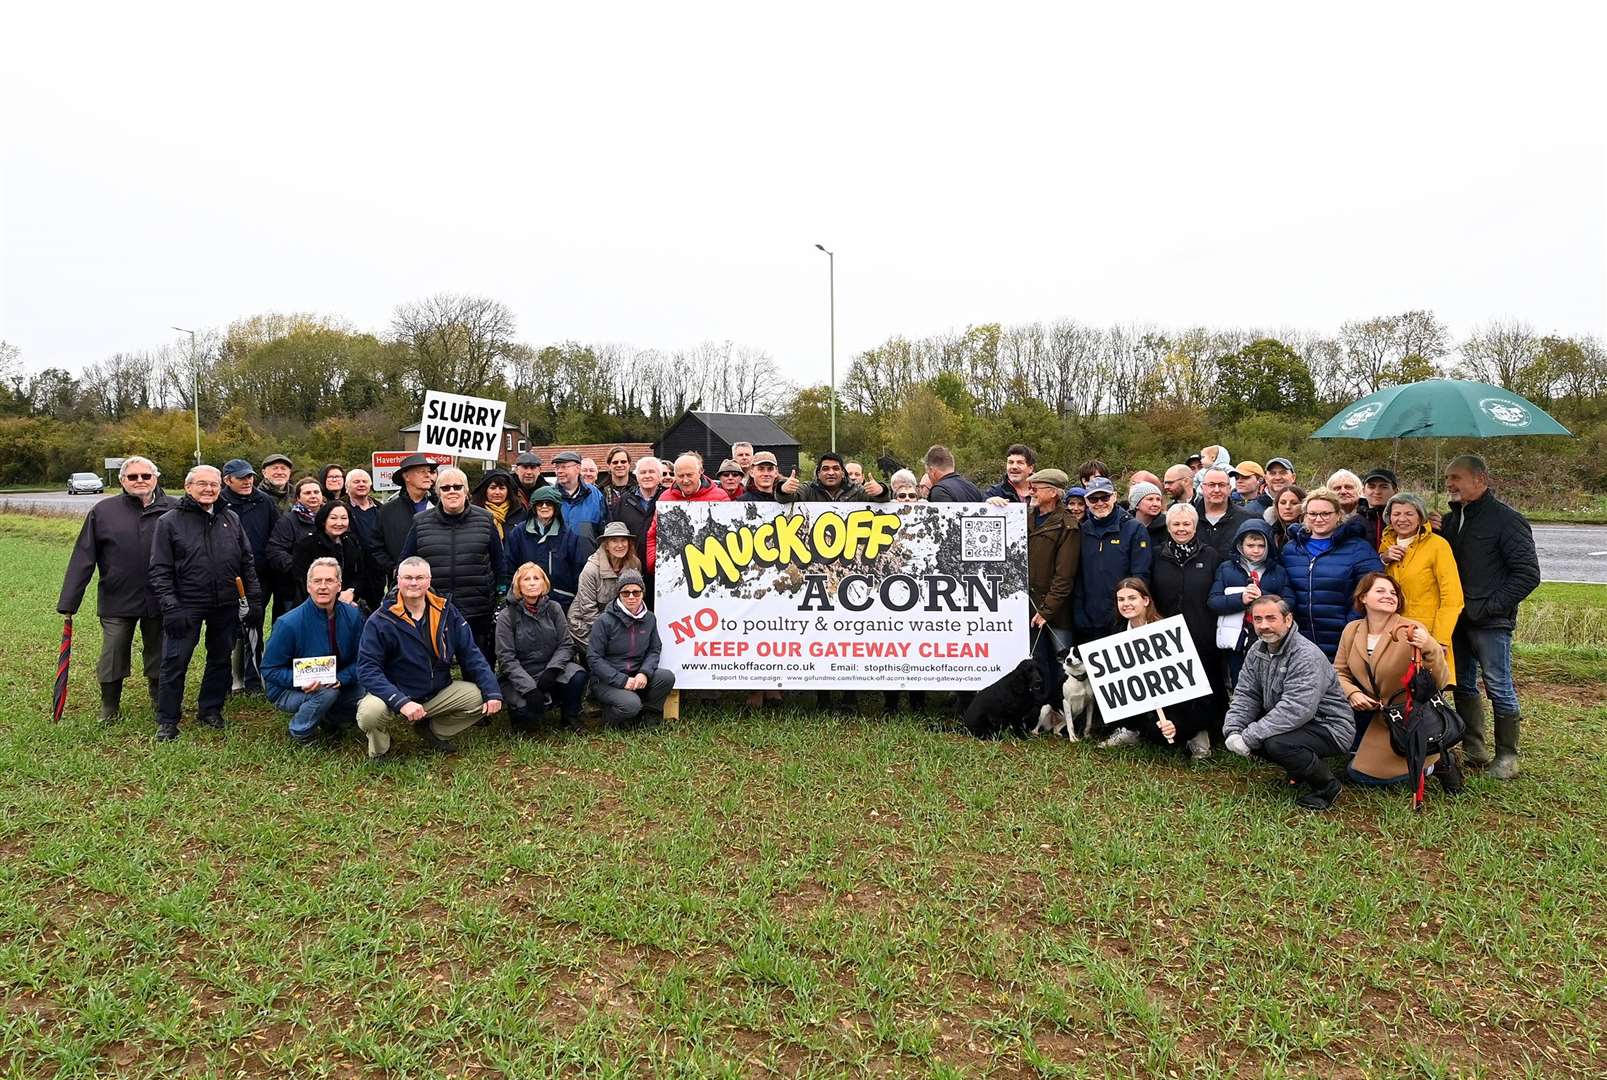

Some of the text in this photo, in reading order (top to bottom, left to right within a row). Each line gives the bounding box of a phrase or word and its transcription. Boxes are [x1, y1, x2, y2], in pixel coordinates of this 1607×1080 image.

[427, 400, 501, 427] SLURRY
[426, 424, 497, 451] WORRY
[683, 510, 902, 597] MUCK OFF
[797, 574, 1003, 612] ACORN
[668, 607, 1013, 645] NO to poultry & organic waste plant
[693, 641, 989, 658] KEEP OUR GATEWAY CLEAN
[1088, 626, 1185, 678] SLURRY
[681, 662, 1001, 674] www.muckoffacorn.co.uk Email: stopthis@muckoffacorn.co.uk
[711, 674, 737, 682] Support
[1099, 659, 1196, 709] WORRY
